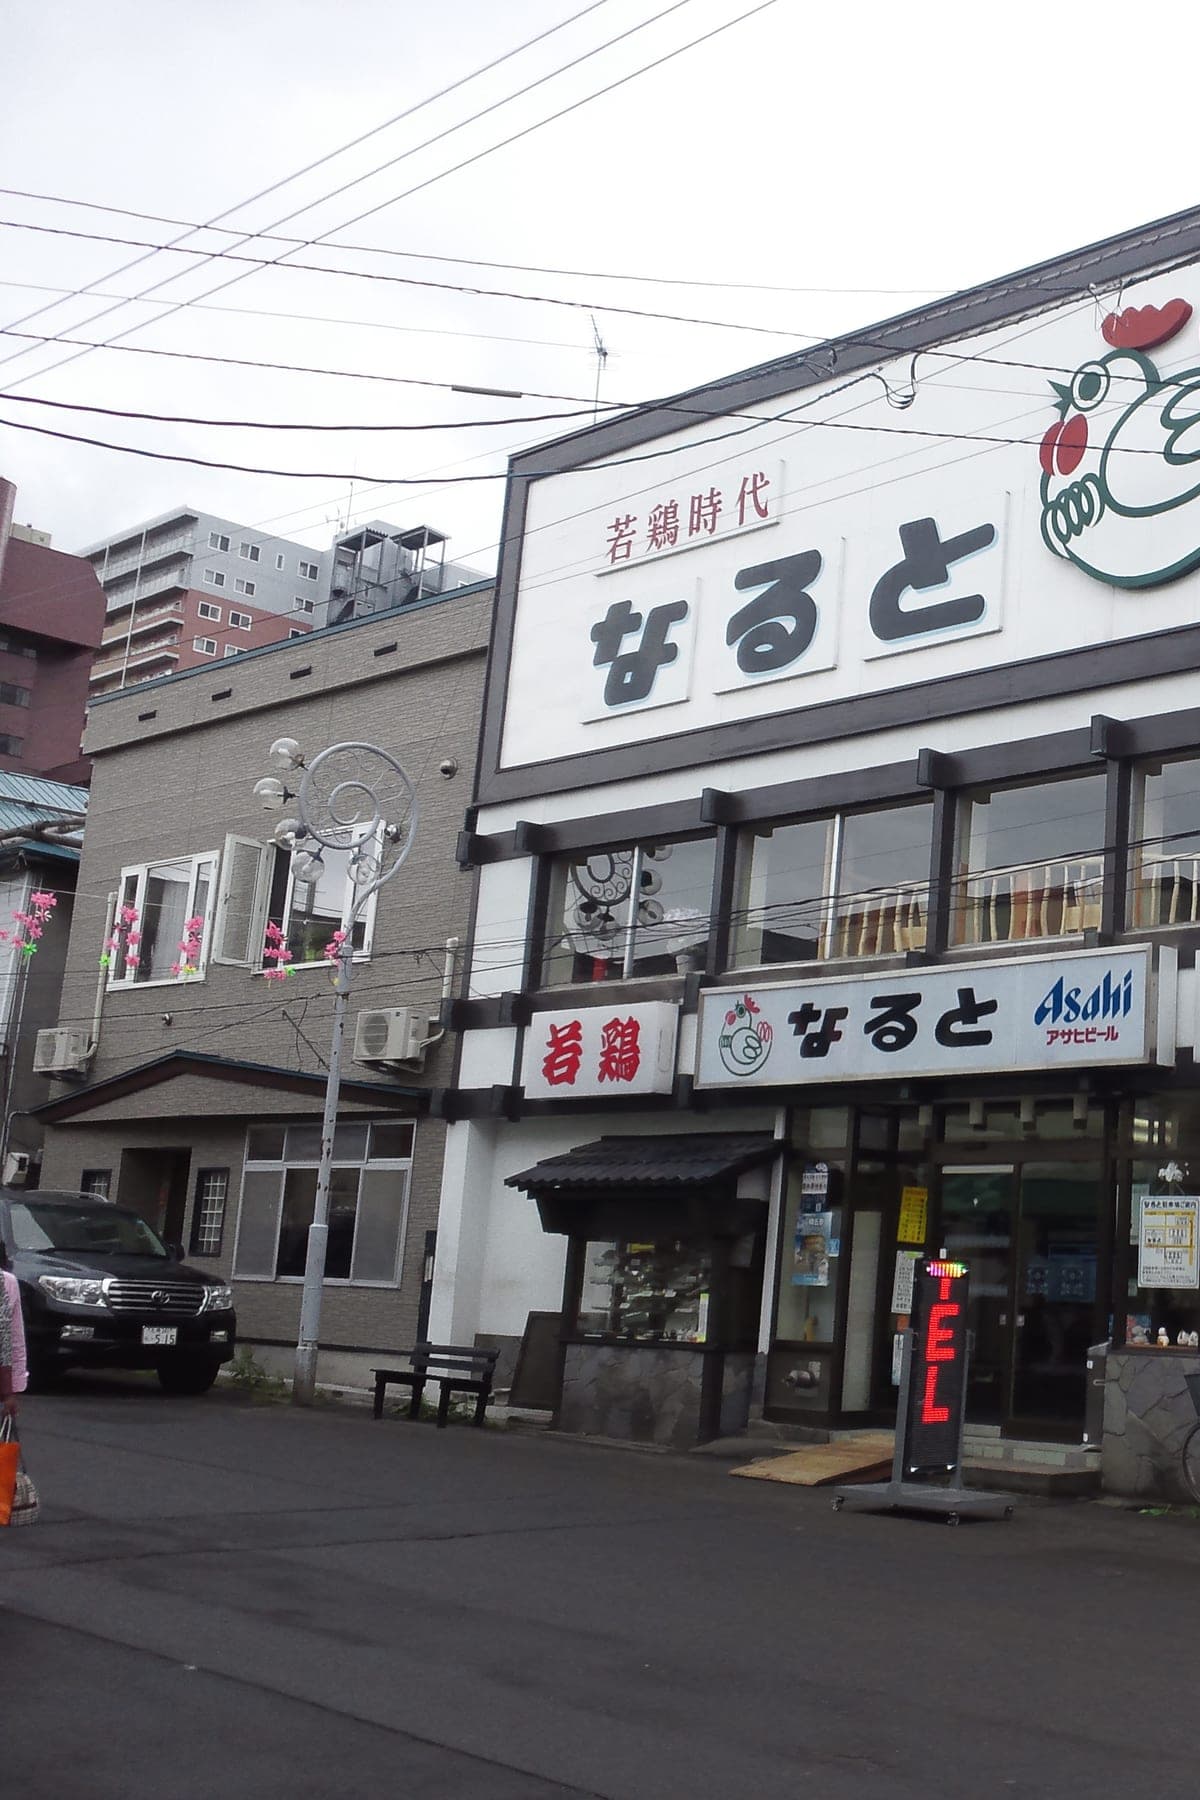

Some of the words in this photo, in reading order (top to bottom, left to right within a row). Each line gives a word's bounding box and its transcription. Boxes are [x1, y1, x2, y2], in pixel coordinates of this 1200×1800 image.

[605, 470, 771, 563] 若鶏時代
[589, 516, 996, 706] なると
[787, 987, 998, 1059] なると
[1034, 968, 1132, 1026] Asahi
[542, 1015, 641, 1087] 若鶏
[1046, 1025, 1119, 1046] アサヒビール
